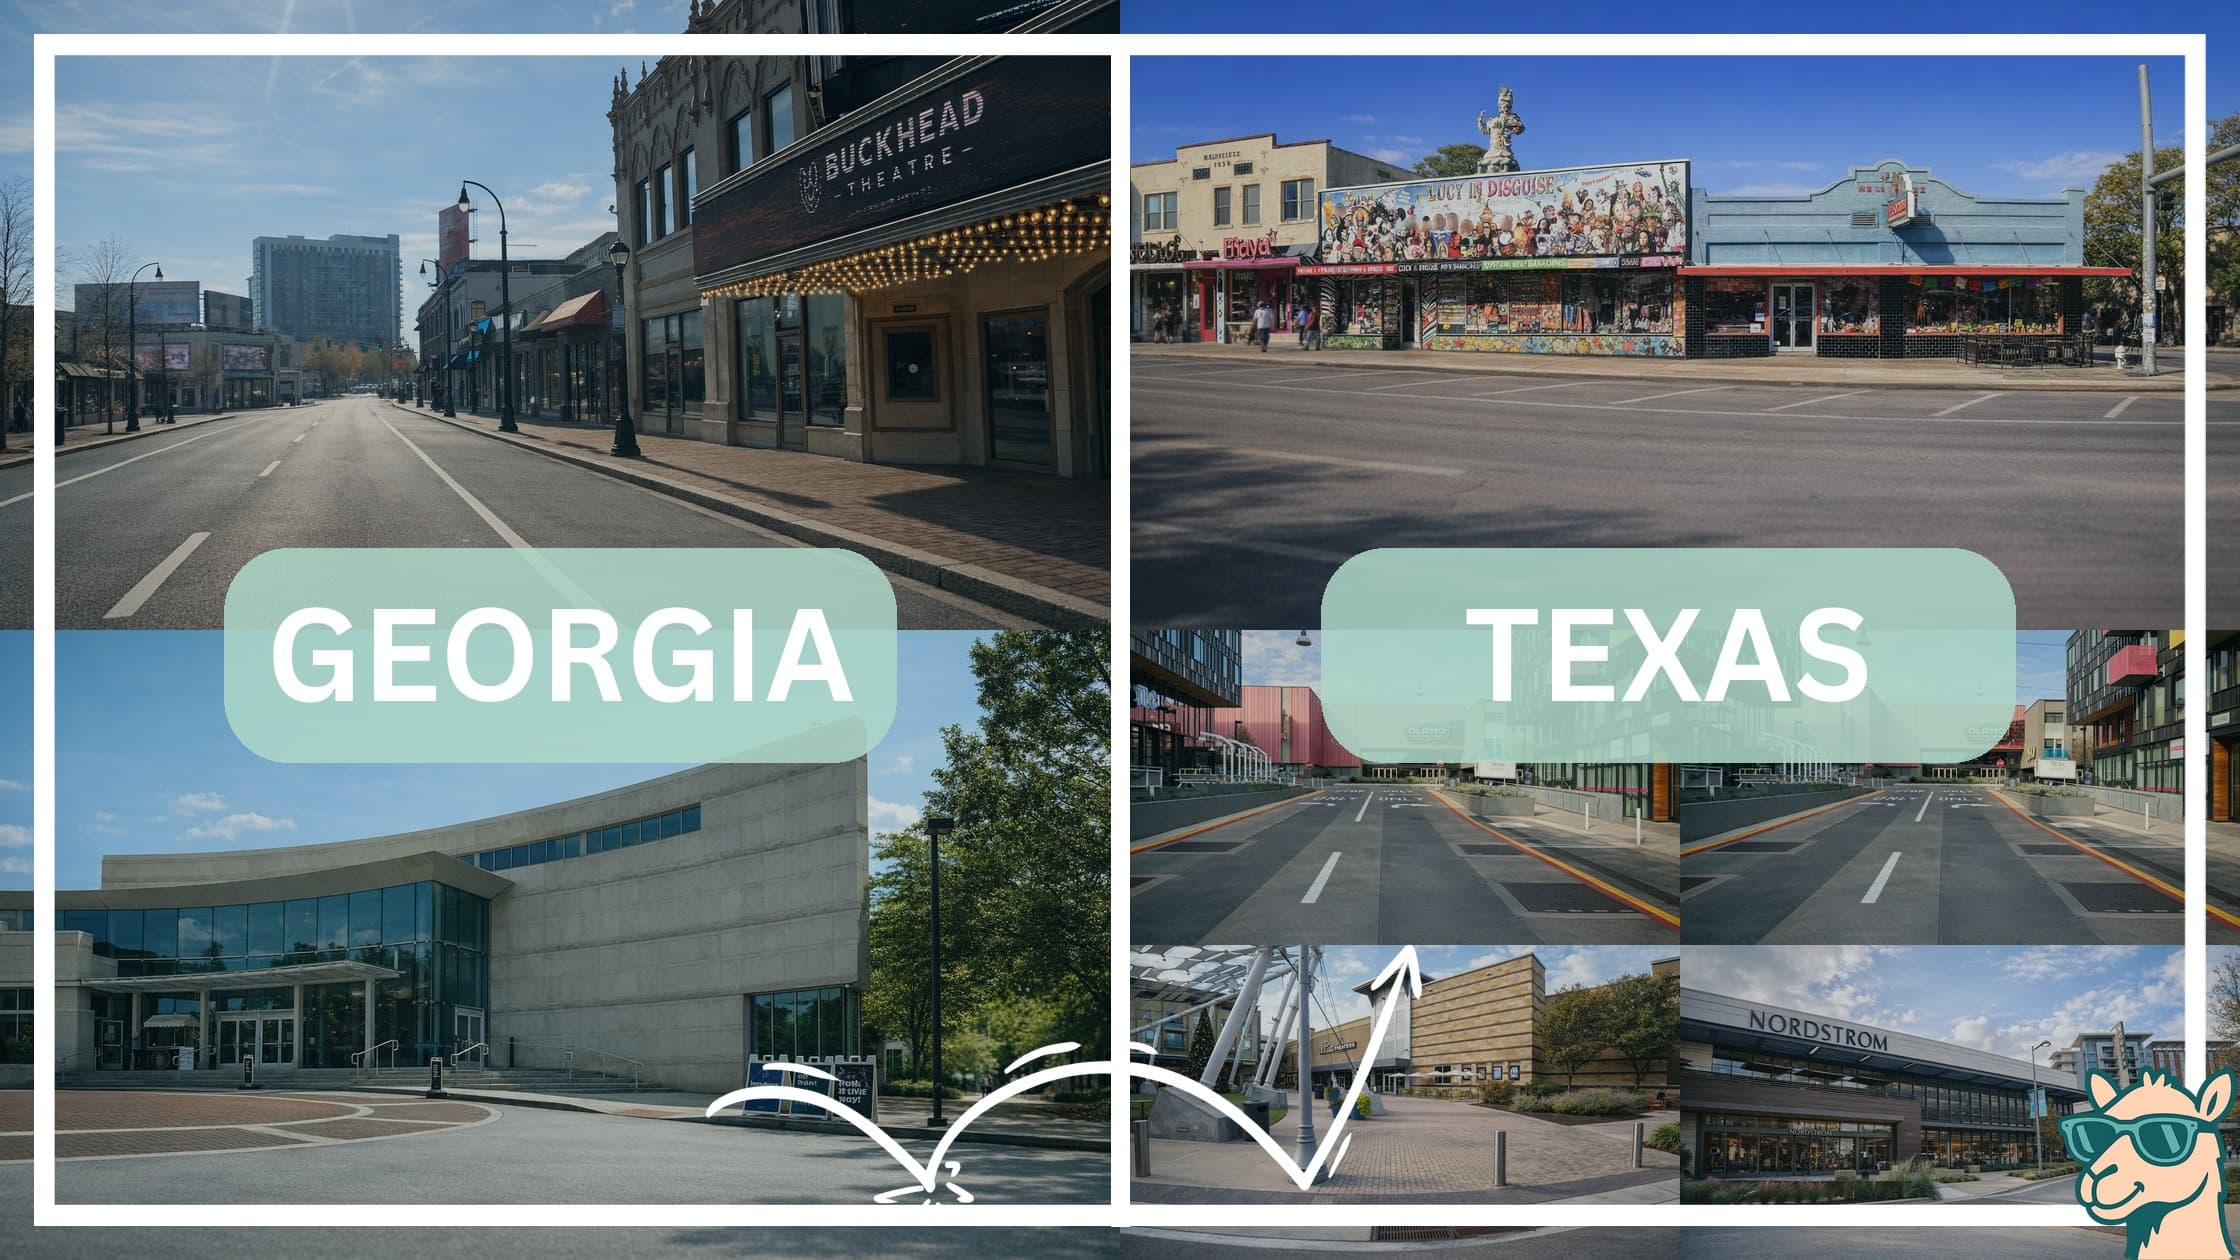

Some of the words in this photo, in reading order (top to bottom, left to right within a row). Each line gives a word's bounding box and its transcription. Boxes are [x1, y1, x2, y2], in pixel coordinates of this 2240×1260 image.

[826, 90, 984, 181] BUCKHEAD
[847, 146, 953, 196] THEATRE
[1428, 182, 1465, 202] LUCY
[1469, 178, 1483, 200] IN
[1487, 175, 1556, 199] DISGUISE
[1750, 1009, 1888, 1051] NORDSTROM
